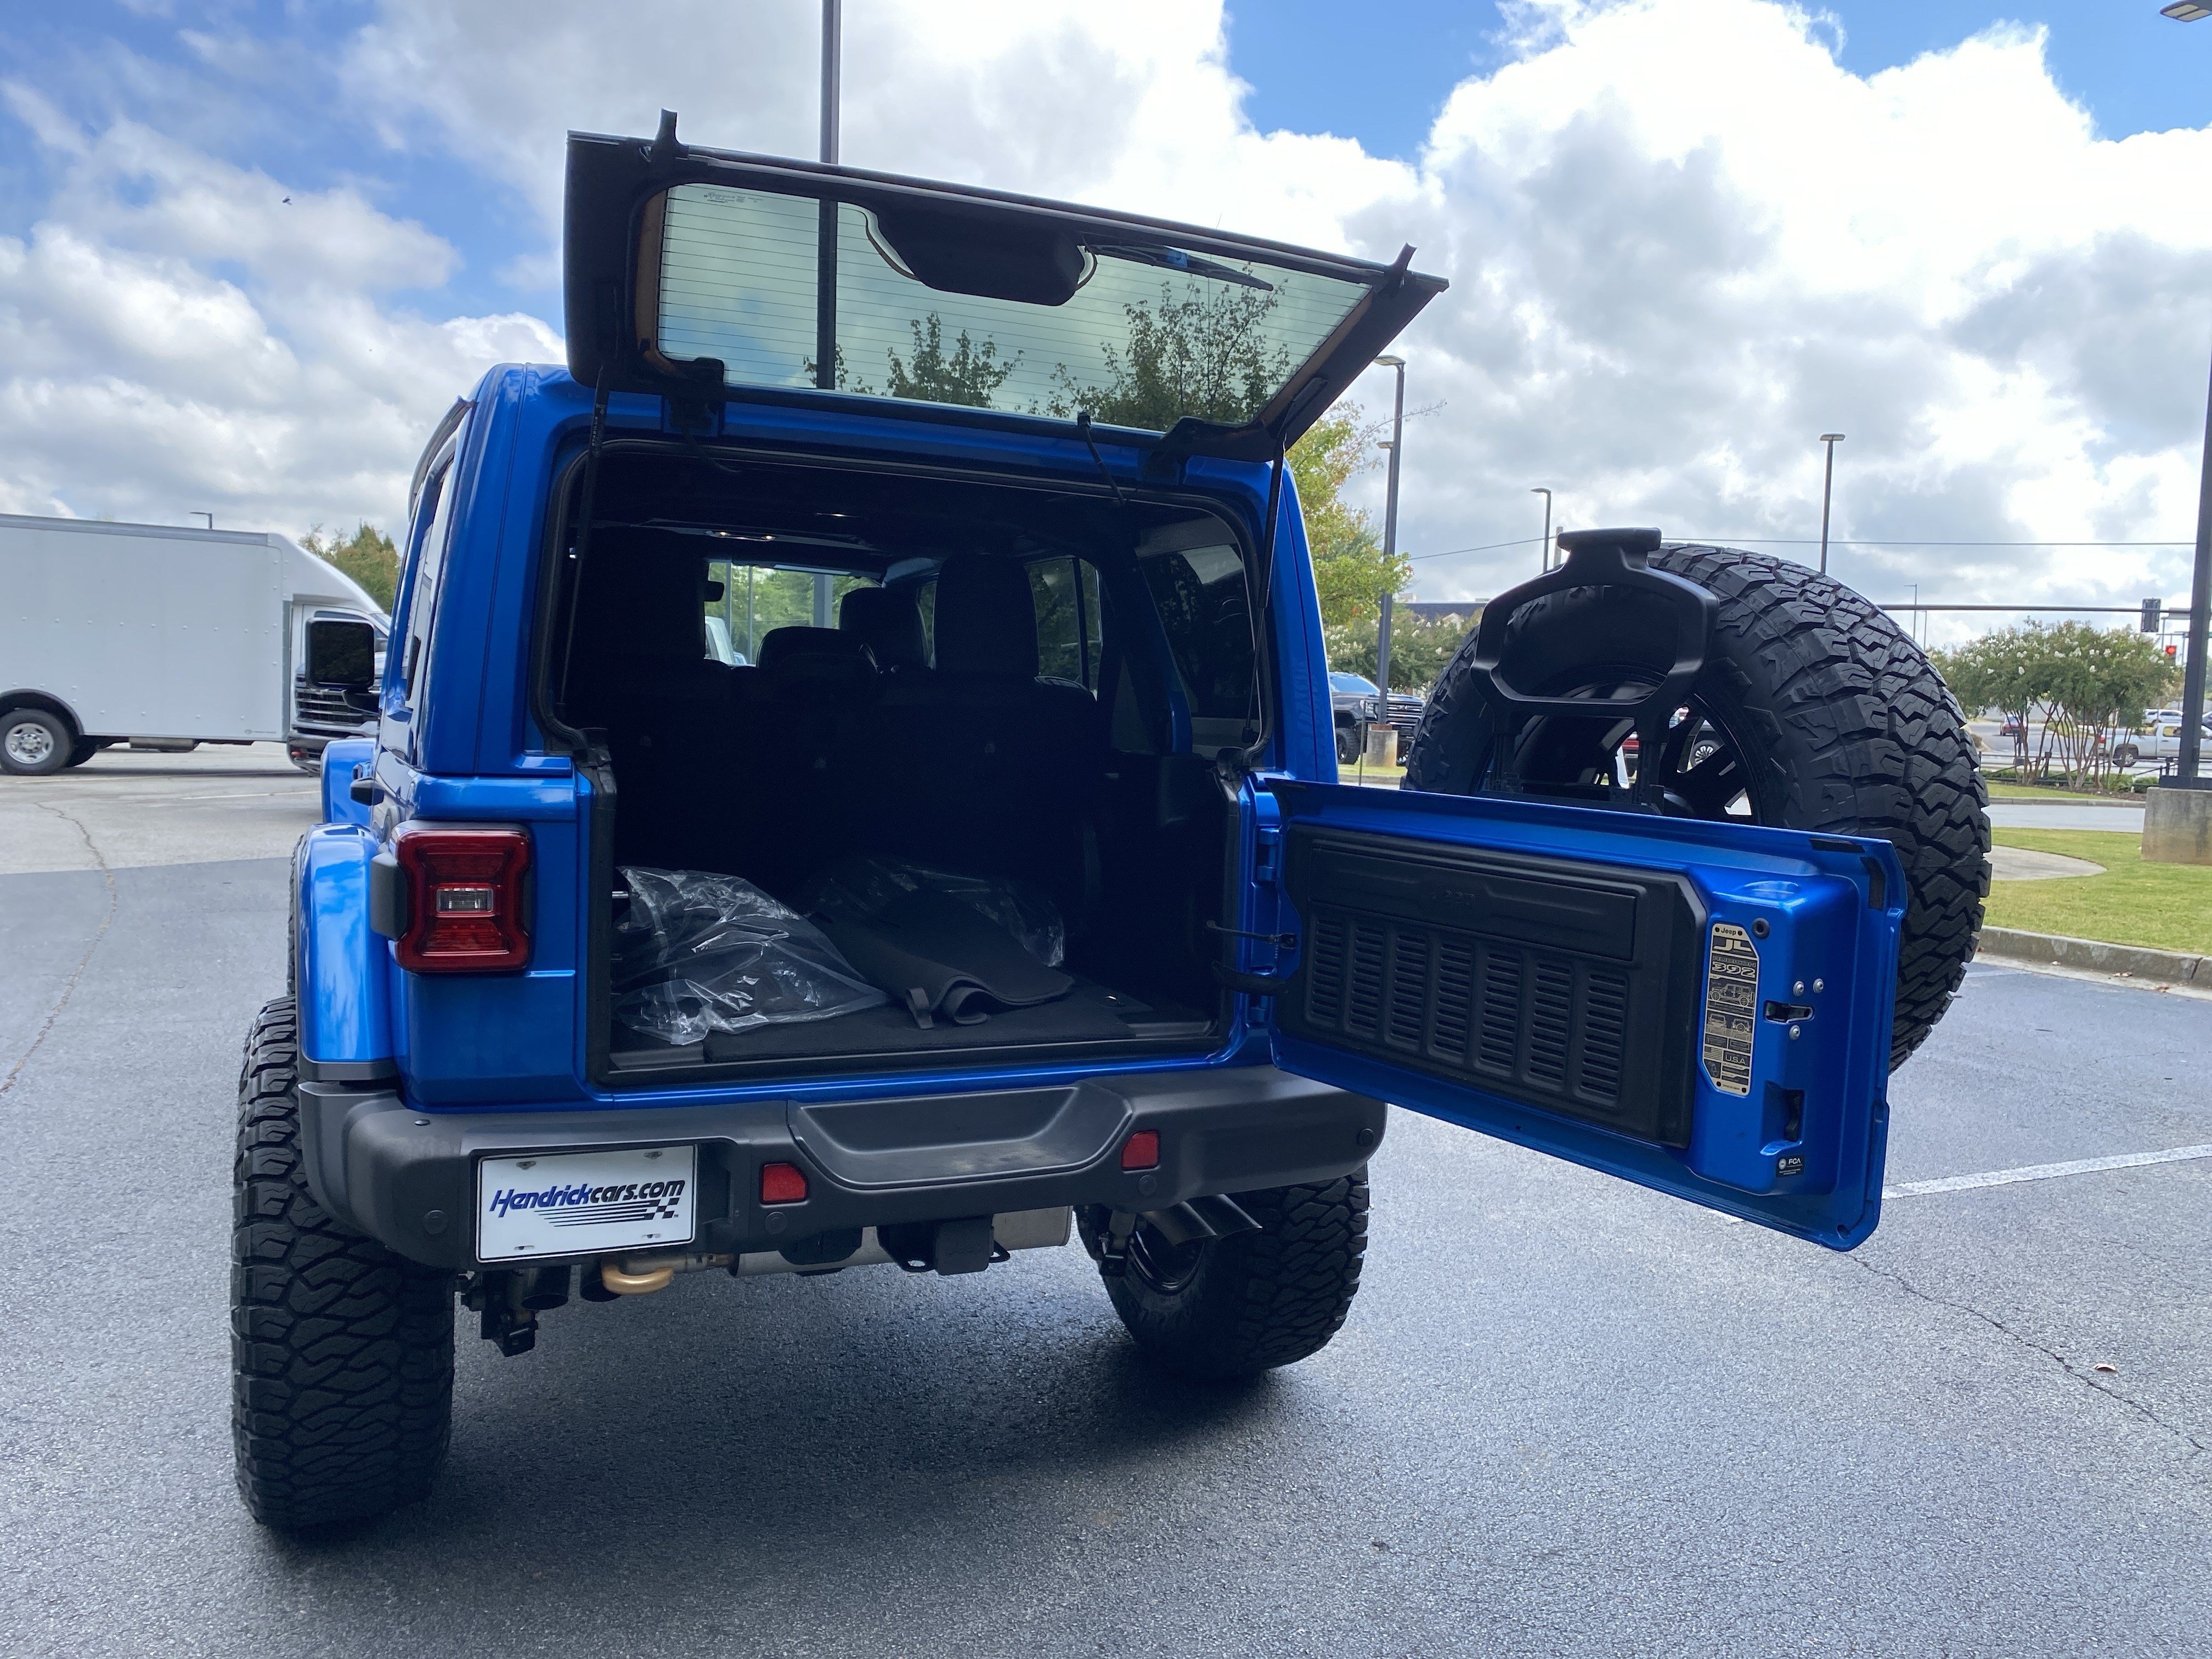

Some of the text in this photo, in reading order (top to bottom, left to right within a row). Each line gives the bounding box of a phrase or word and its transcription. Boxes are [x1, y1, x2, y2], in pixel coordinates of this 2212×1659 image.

[1720, 927, 1736, 936] Jeep
[1713, 939, 1752, 952] JL
[1712, 961, 1756, 978] 392
[1725, 1054, 1747, 1065] USA
[489, 1180, 685, 1218] Hendrickcars.com
